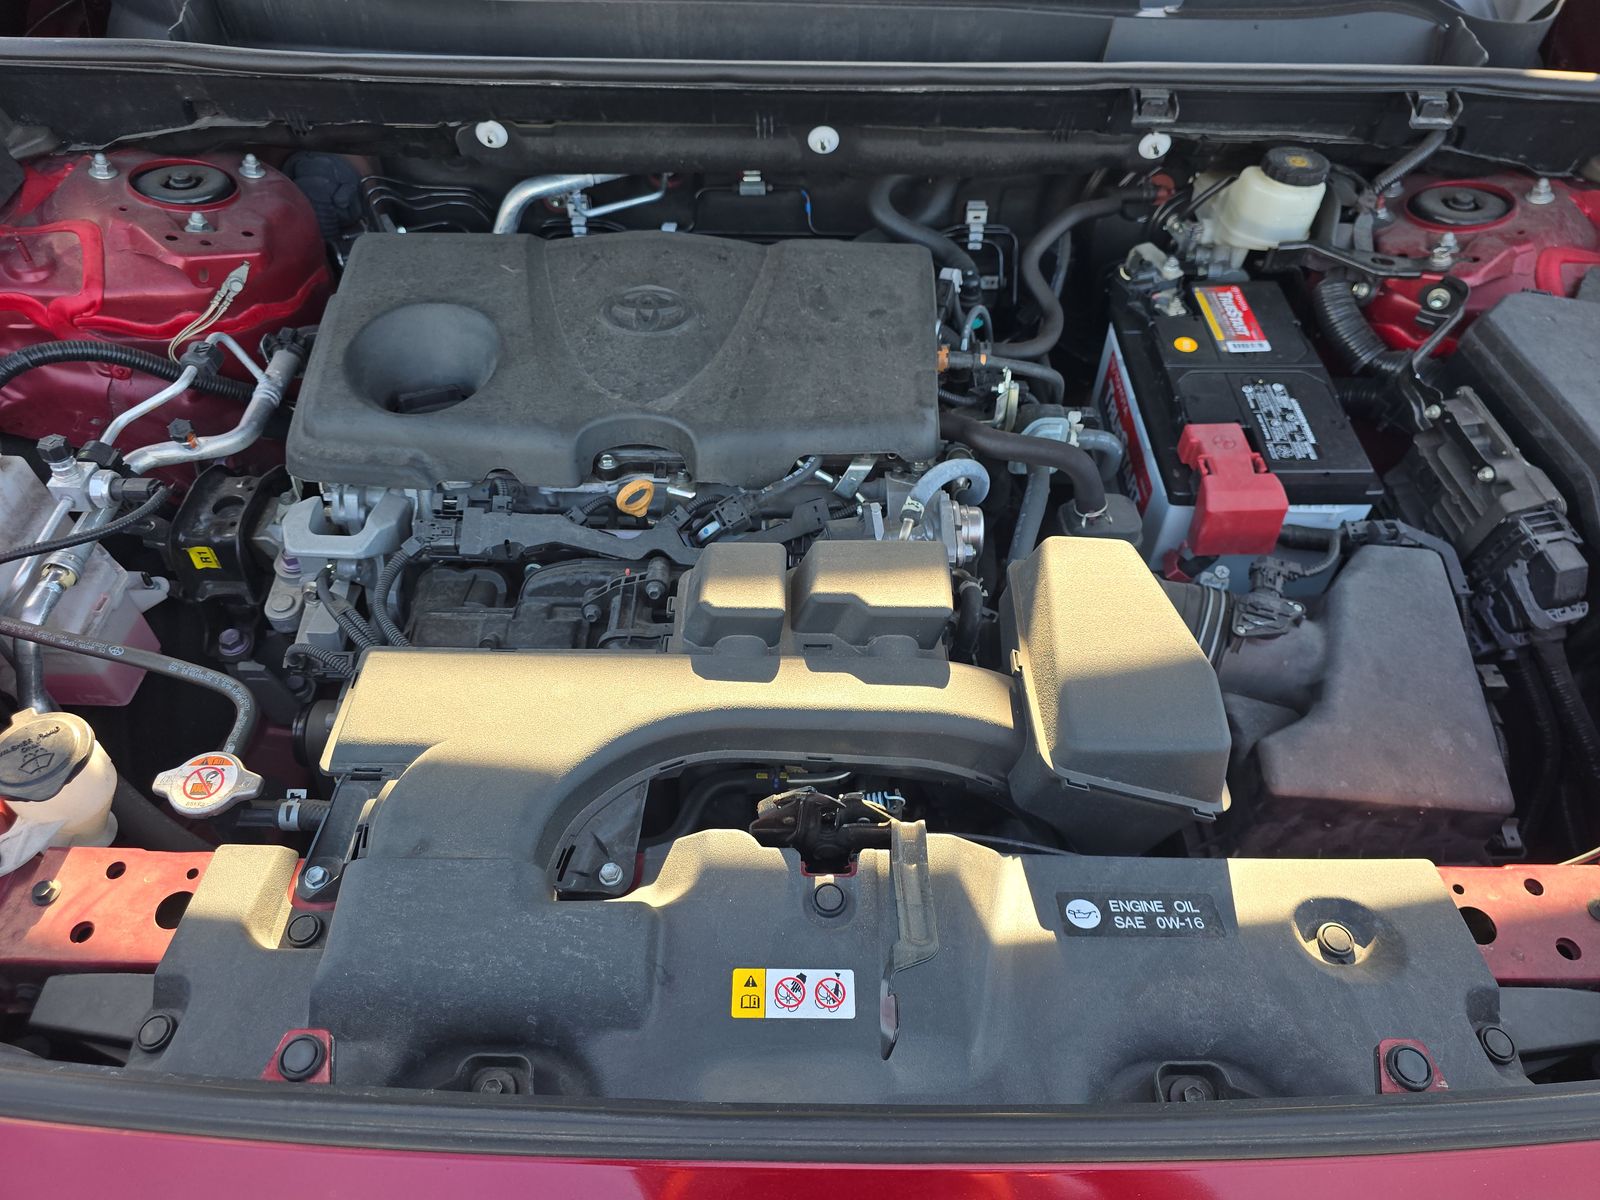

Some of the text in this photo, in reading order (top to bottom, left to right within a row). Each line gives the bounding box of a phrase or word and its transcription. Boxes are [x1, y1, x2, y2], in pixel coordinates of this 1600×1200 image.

[197, 551, 213, 564] R1
[1108, 899, 1200, 913] ENGINE OIL
[1114, 915, 1205, 930] SAE 0W-16
